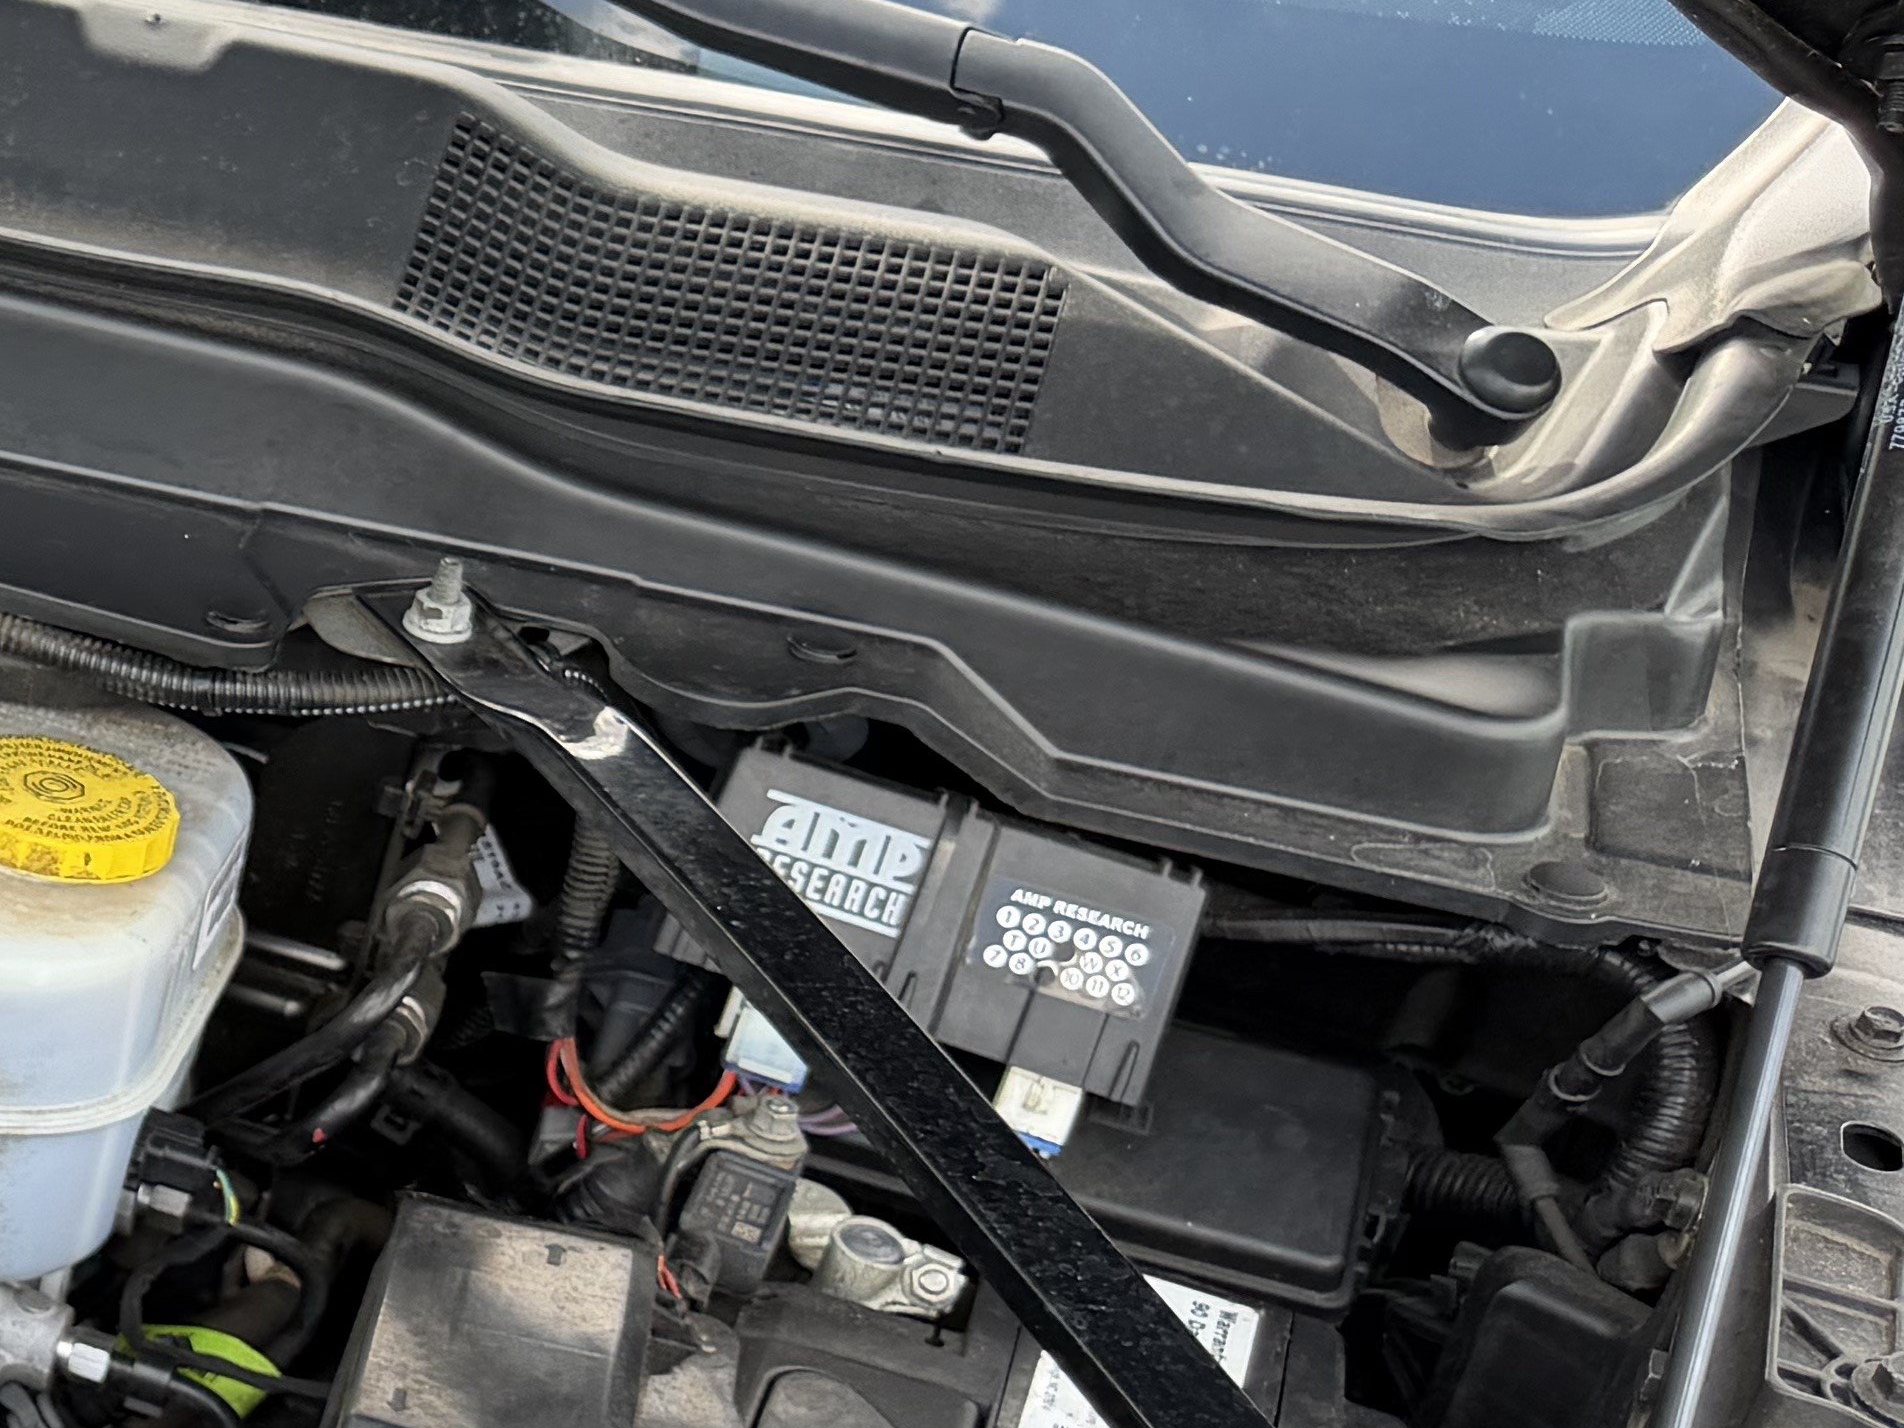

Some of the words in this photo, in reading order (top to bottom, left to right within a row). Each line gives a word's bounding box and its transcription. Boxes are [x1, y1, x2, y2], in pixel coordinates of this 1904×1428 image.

[750, 788, 932, 894] AMP
[1010, 888, 1052, 910] AMP
[1052, 900, 1150, 940] RESEARCH
